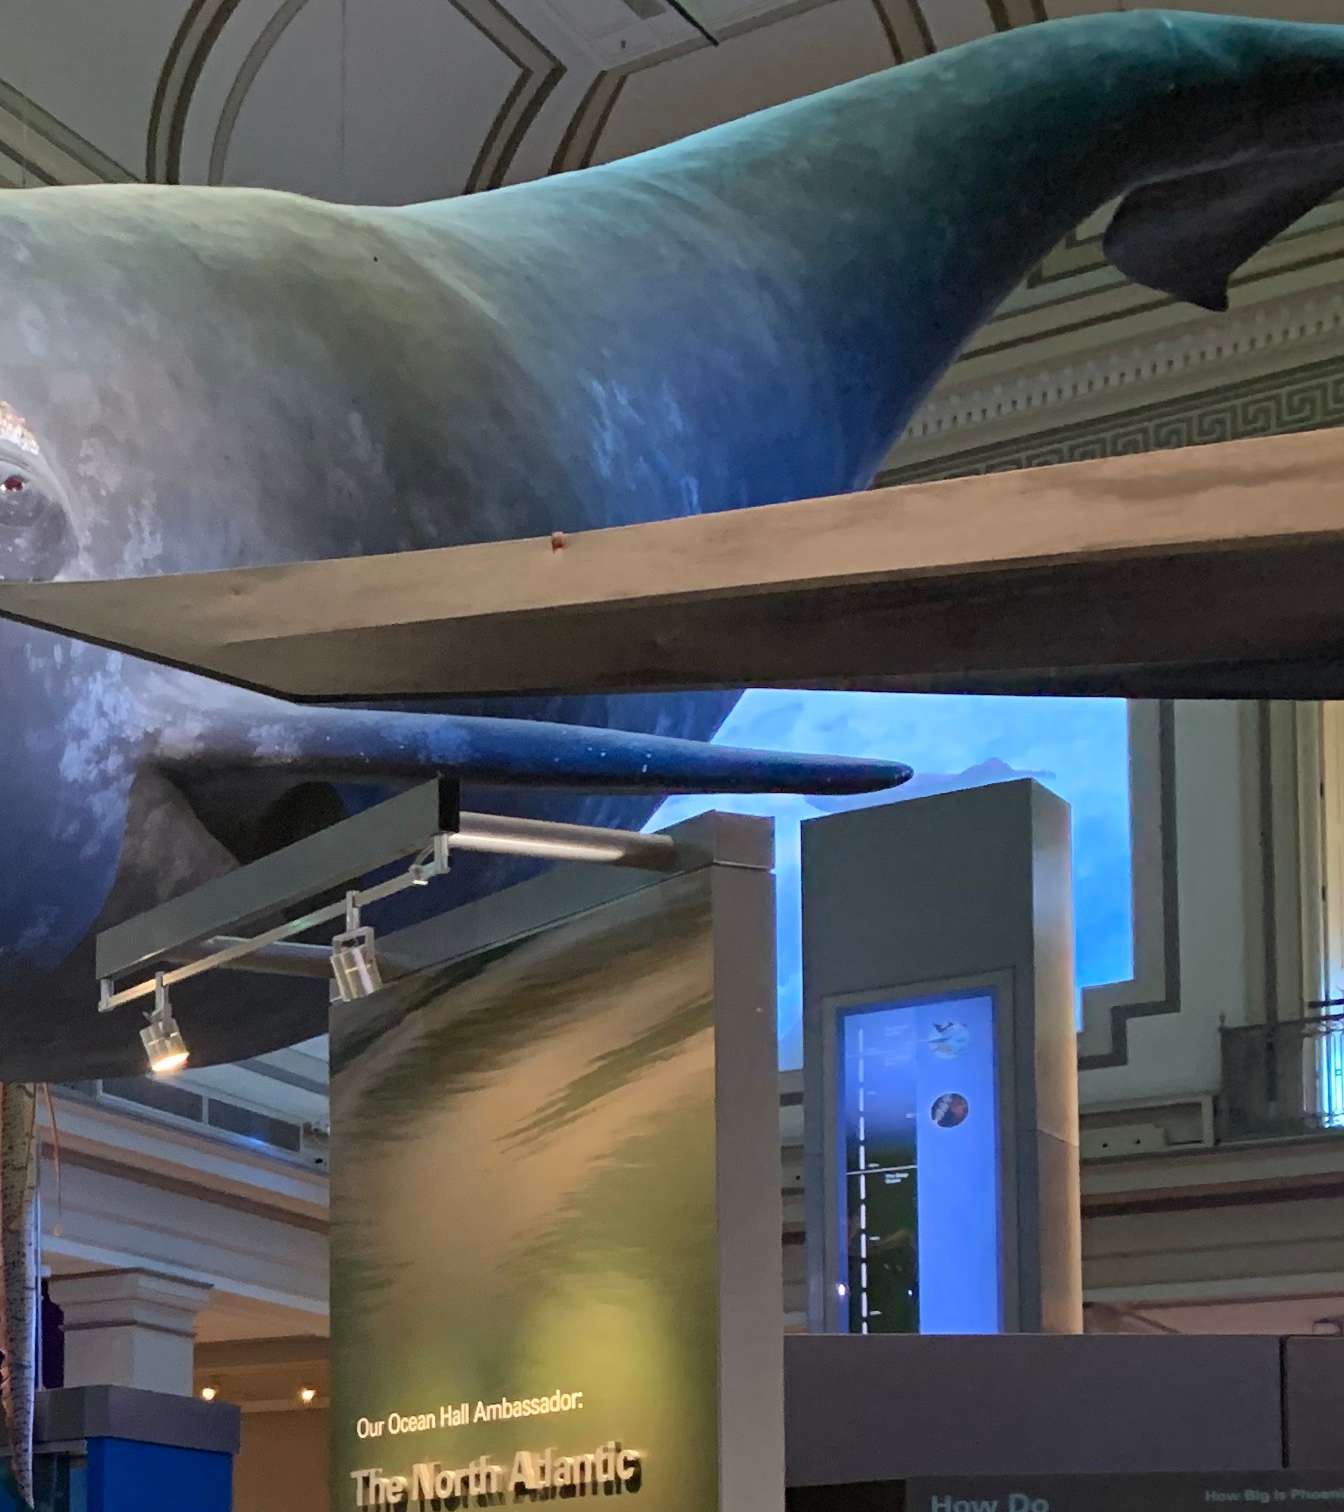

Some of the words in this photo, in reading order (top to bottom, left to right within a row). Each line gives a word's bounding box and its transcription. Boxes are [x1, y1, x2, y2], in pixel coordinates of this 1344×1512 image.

[356, 1417, 384, 1438] Our
[388, 1412, 436, 1435] Ocean
[440, 1402, 470, 1427] Hall
[473, 1389, 584, 1423] Ambassador:
[350, 1466, 409, 1507] The
[411, 1453, 505, 1501] North
[509, 1440, 643, 1490] Atlantic
